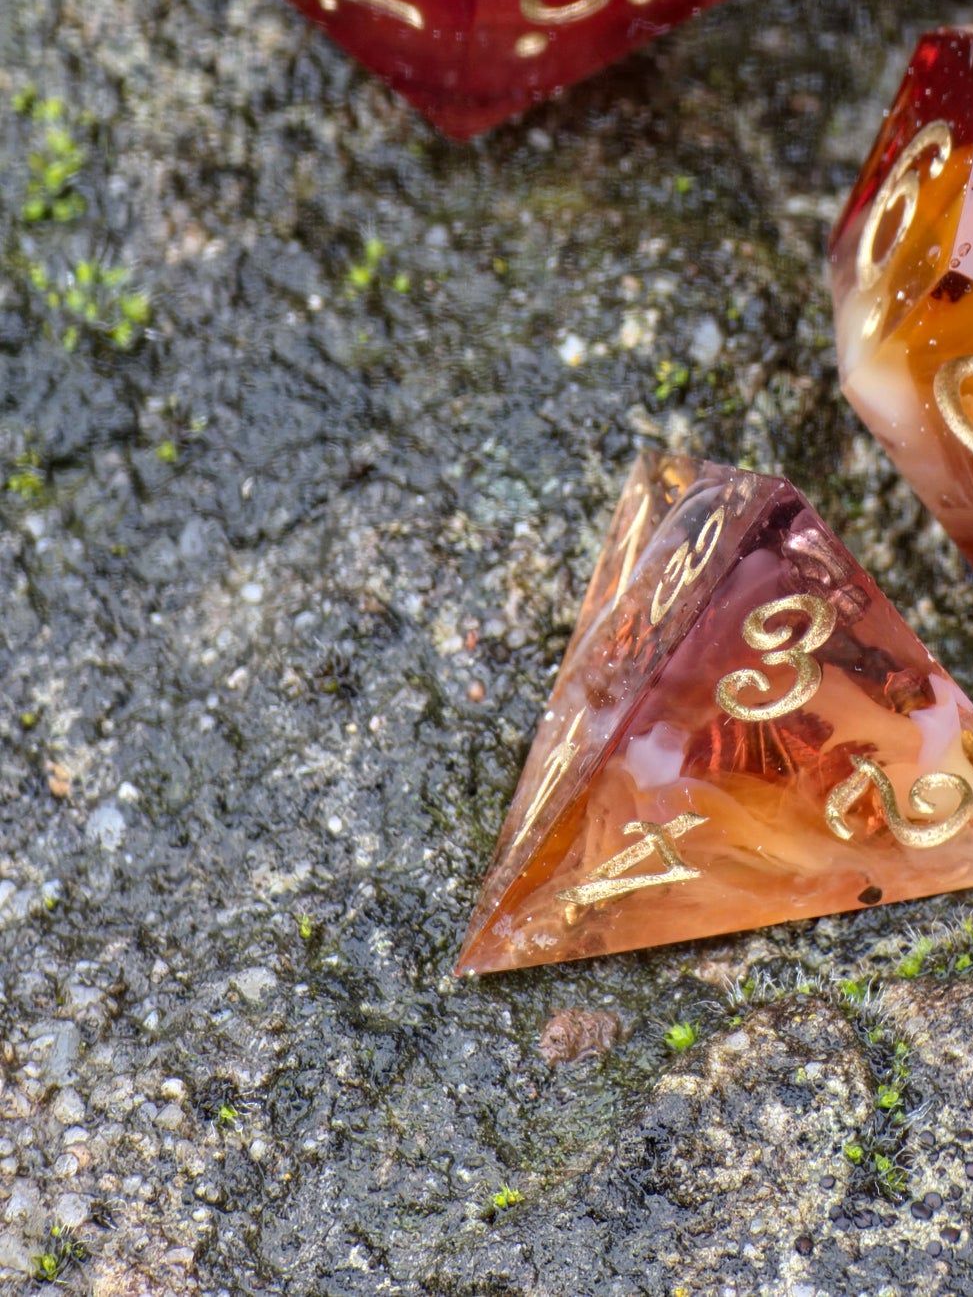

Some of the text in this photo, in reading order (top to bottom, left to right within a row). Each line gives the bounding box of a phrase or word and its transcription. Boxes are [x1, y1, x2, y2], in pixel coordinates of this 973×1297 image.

[649, 504, 726, 627] 3
[714, 592, 838, 723] 3
[554, 809, 710, 905] 4
